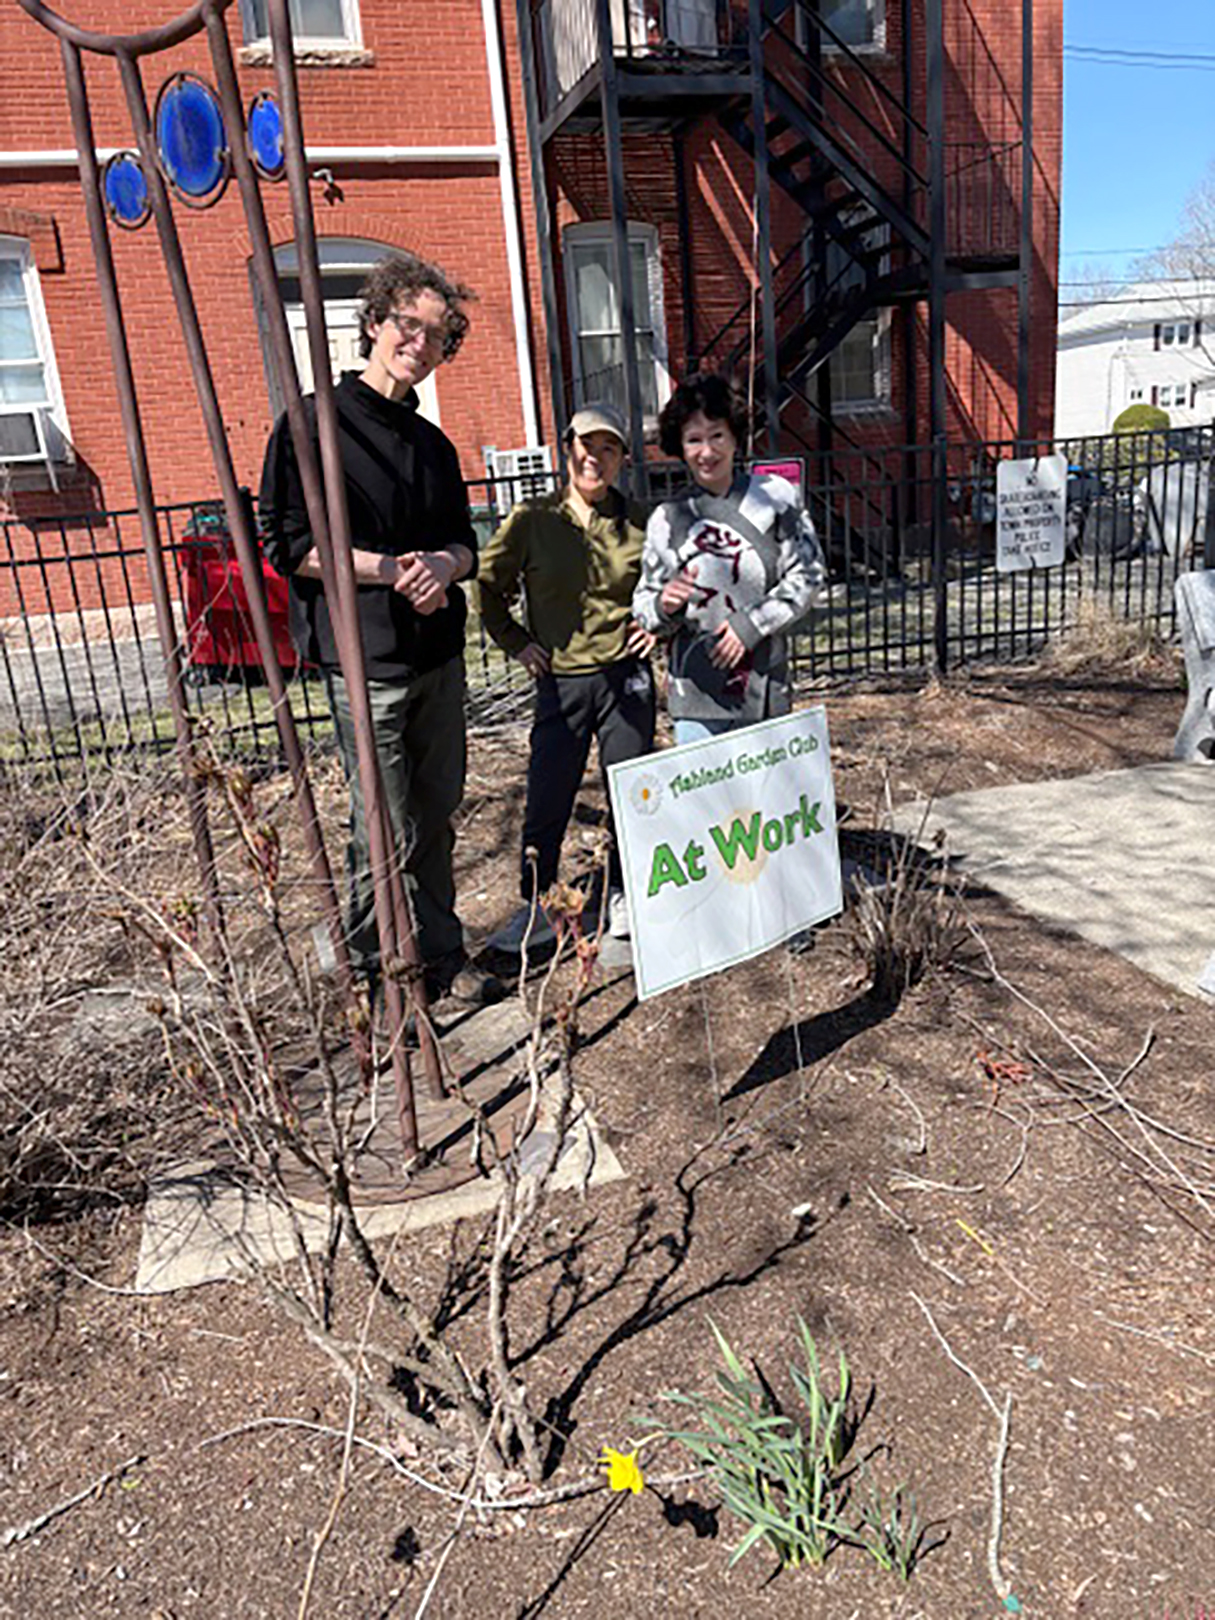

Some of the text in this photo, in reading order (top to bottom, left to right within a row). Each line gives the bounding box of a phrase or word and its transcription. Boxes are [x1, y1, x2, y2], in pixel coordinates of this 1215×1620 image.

[737, 747, 787, 774] Garden
[789, 734, 819, 757] Club
[648, 793, 825, 899] At Work
